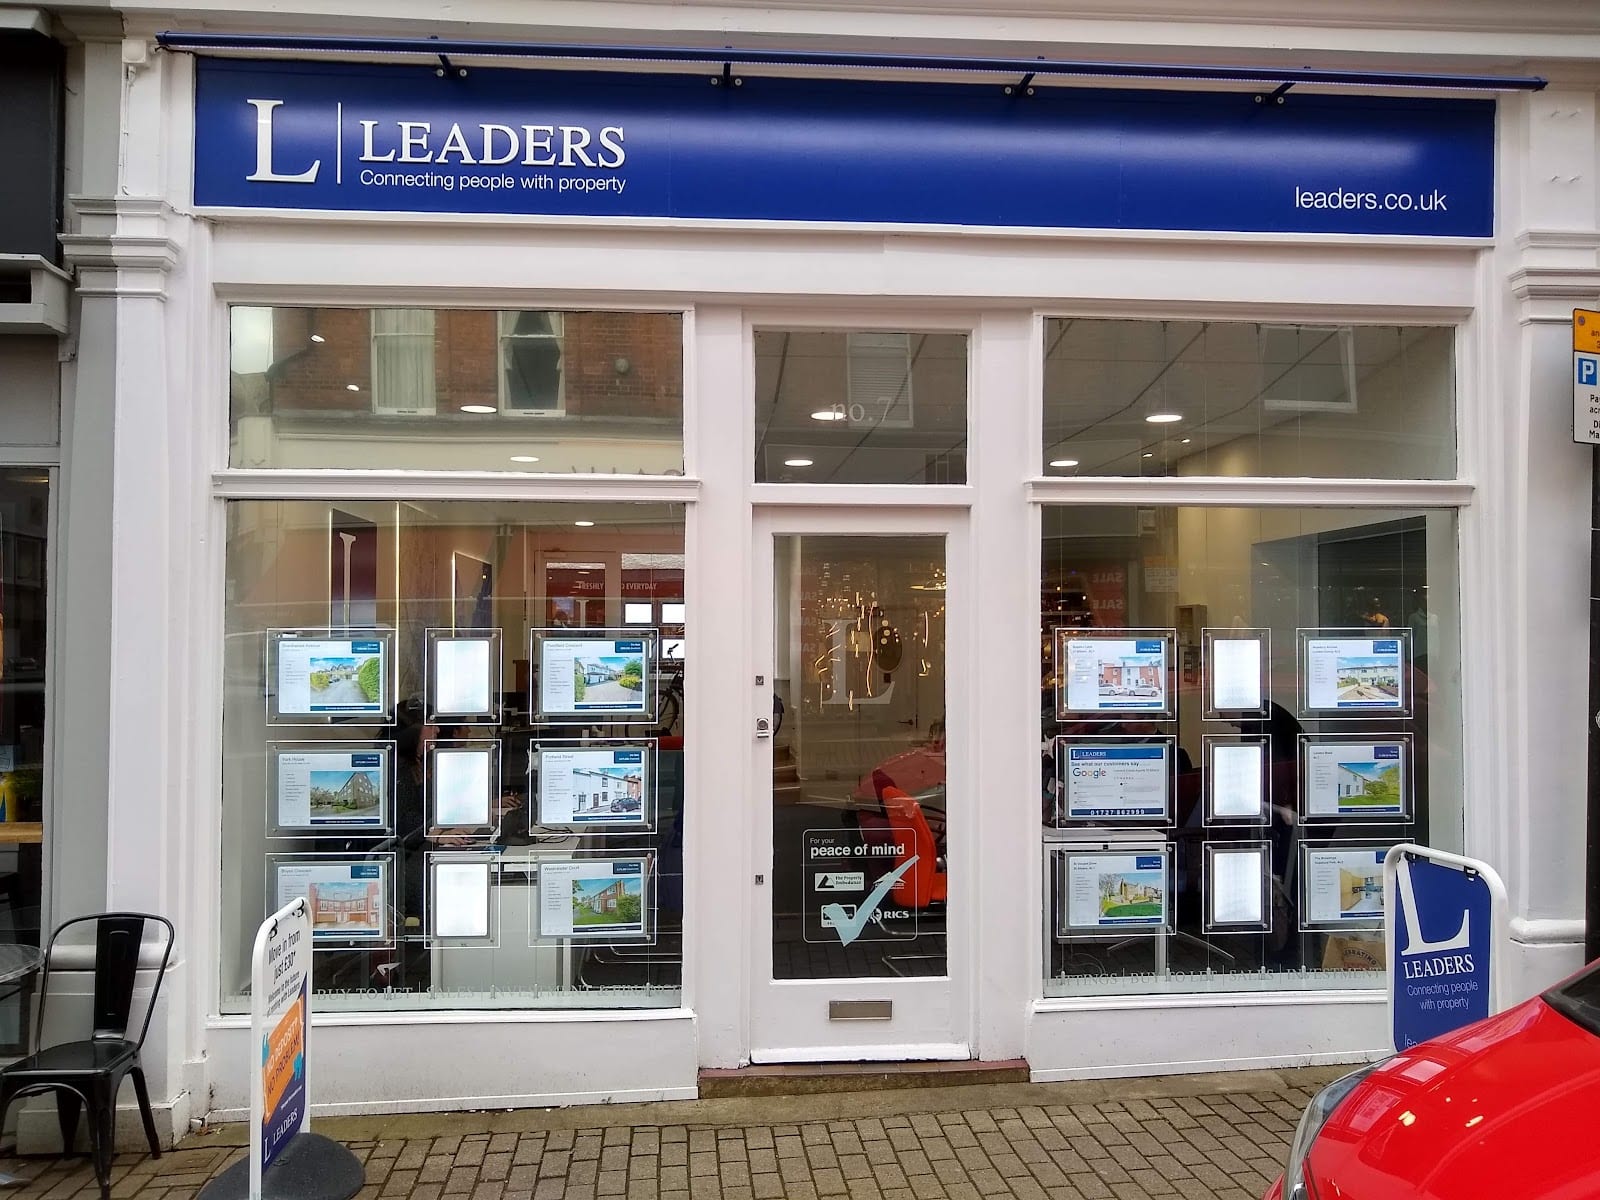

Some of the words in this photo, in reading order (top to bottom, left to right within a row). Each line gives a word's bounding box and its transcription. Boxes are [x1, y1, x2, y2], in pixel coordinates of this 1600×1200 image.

[246, 99, 321, 183] L
[359, 120, 626, 169] LEADERS
[360, 169, 454, 191] Connecting
[459, 172, 514, 192] people
[521, 174, 553, 191] with
[558, 175, 626, 194] property
[1295, 187, 1447, 211] leaders.co.uk
[1582, 361, 1594, 382] P
[1590, 394, 1600, 403] Pa
[1072, 767, 1107, 779] Google
[810, 845, 852, 859] peace
[854, 844, 868, 856] of
[871, 843, 905, 856] mind
[1396, 852, 1470, 955] L
[883, 910, 910, 919] RICS
[288, 930, 301, 948] from
[1403, 954, 1475, 979] LEADERS
[1055, 973, 1117, 986] LTTINGS
[1130, 972, 1159, 984] BUY
[317, 988, 350, 1001] BUY
[356, 988, 378, 1000] TO
[1407, 982, 1449, 997] Connecting
[1450, 980, 1479, 995] people
[1419, 999, 1436, 1010] with
[1436, 997, 1470, 1011] property
[272, 1107, 298, 1146] LEADERS
